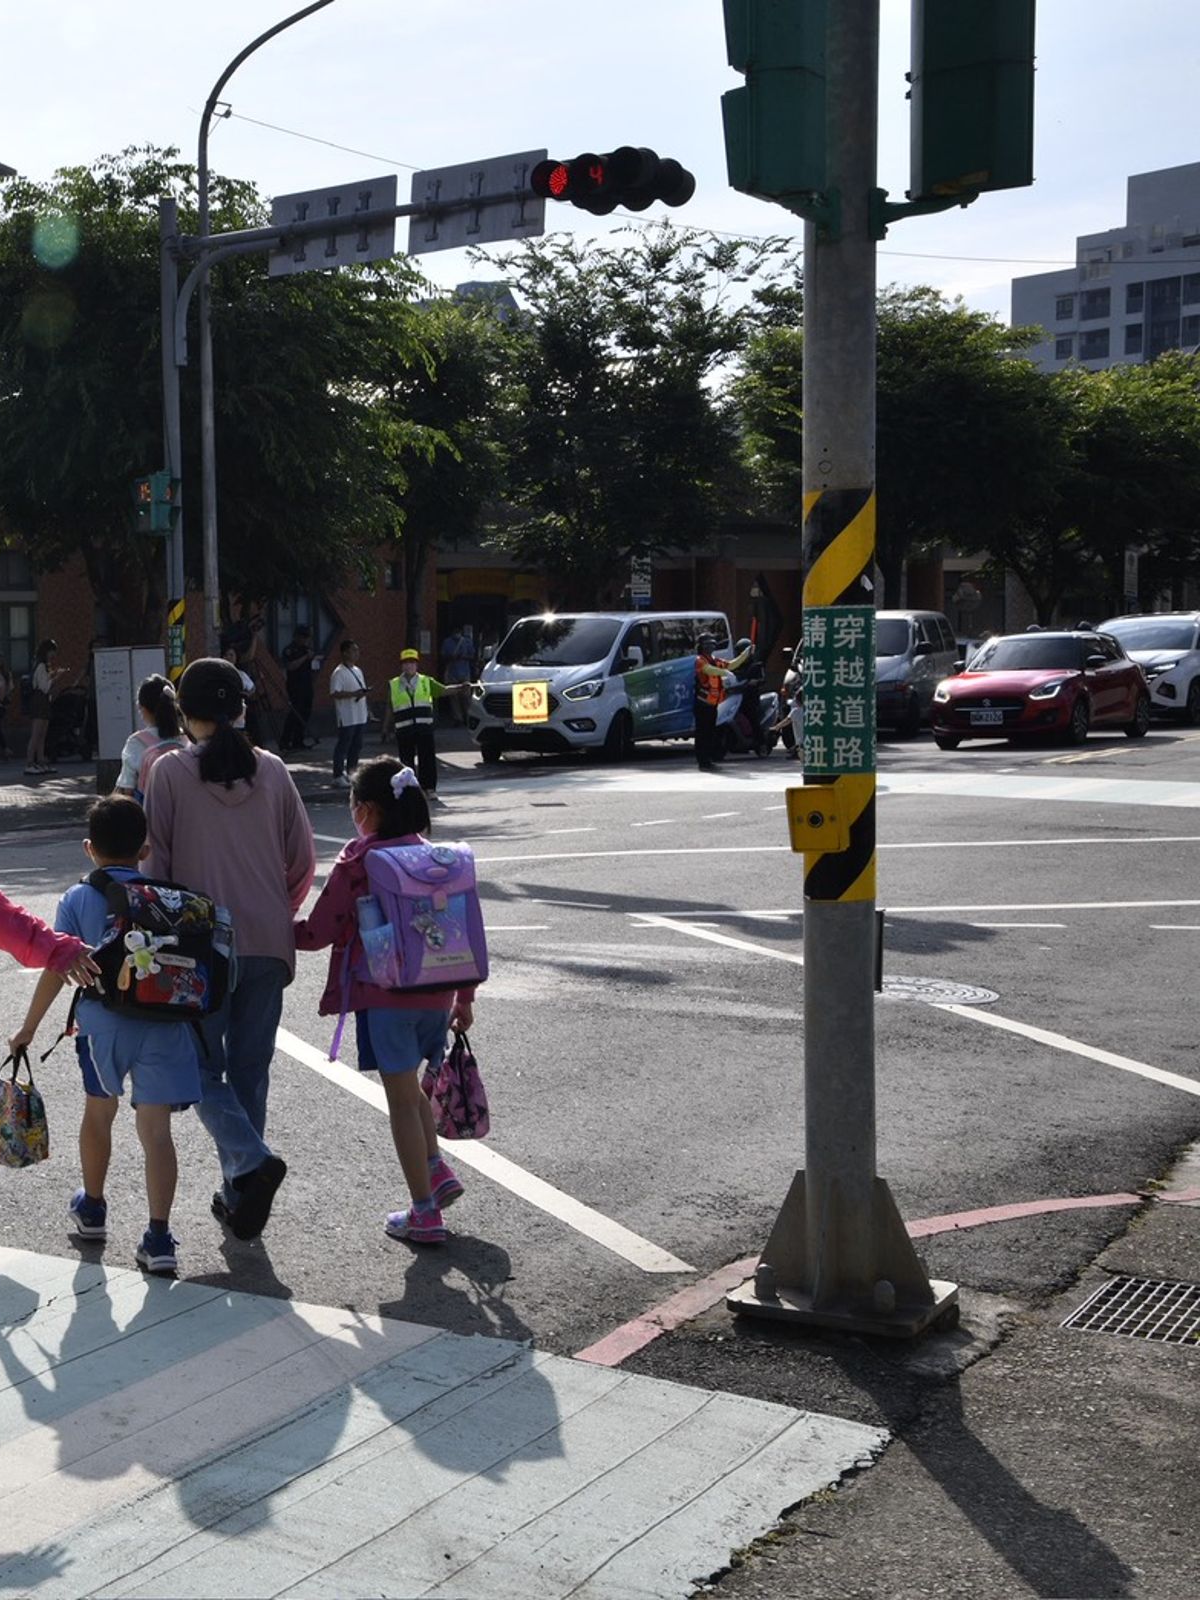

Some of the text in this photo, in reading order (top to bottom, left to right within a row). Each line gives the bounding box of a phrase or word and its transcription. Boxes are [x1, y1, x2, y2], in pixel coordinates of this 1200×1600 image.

[803, 614, 829, 768] 請先按鈕
[832, 613, 866, 768] 穿越道路
